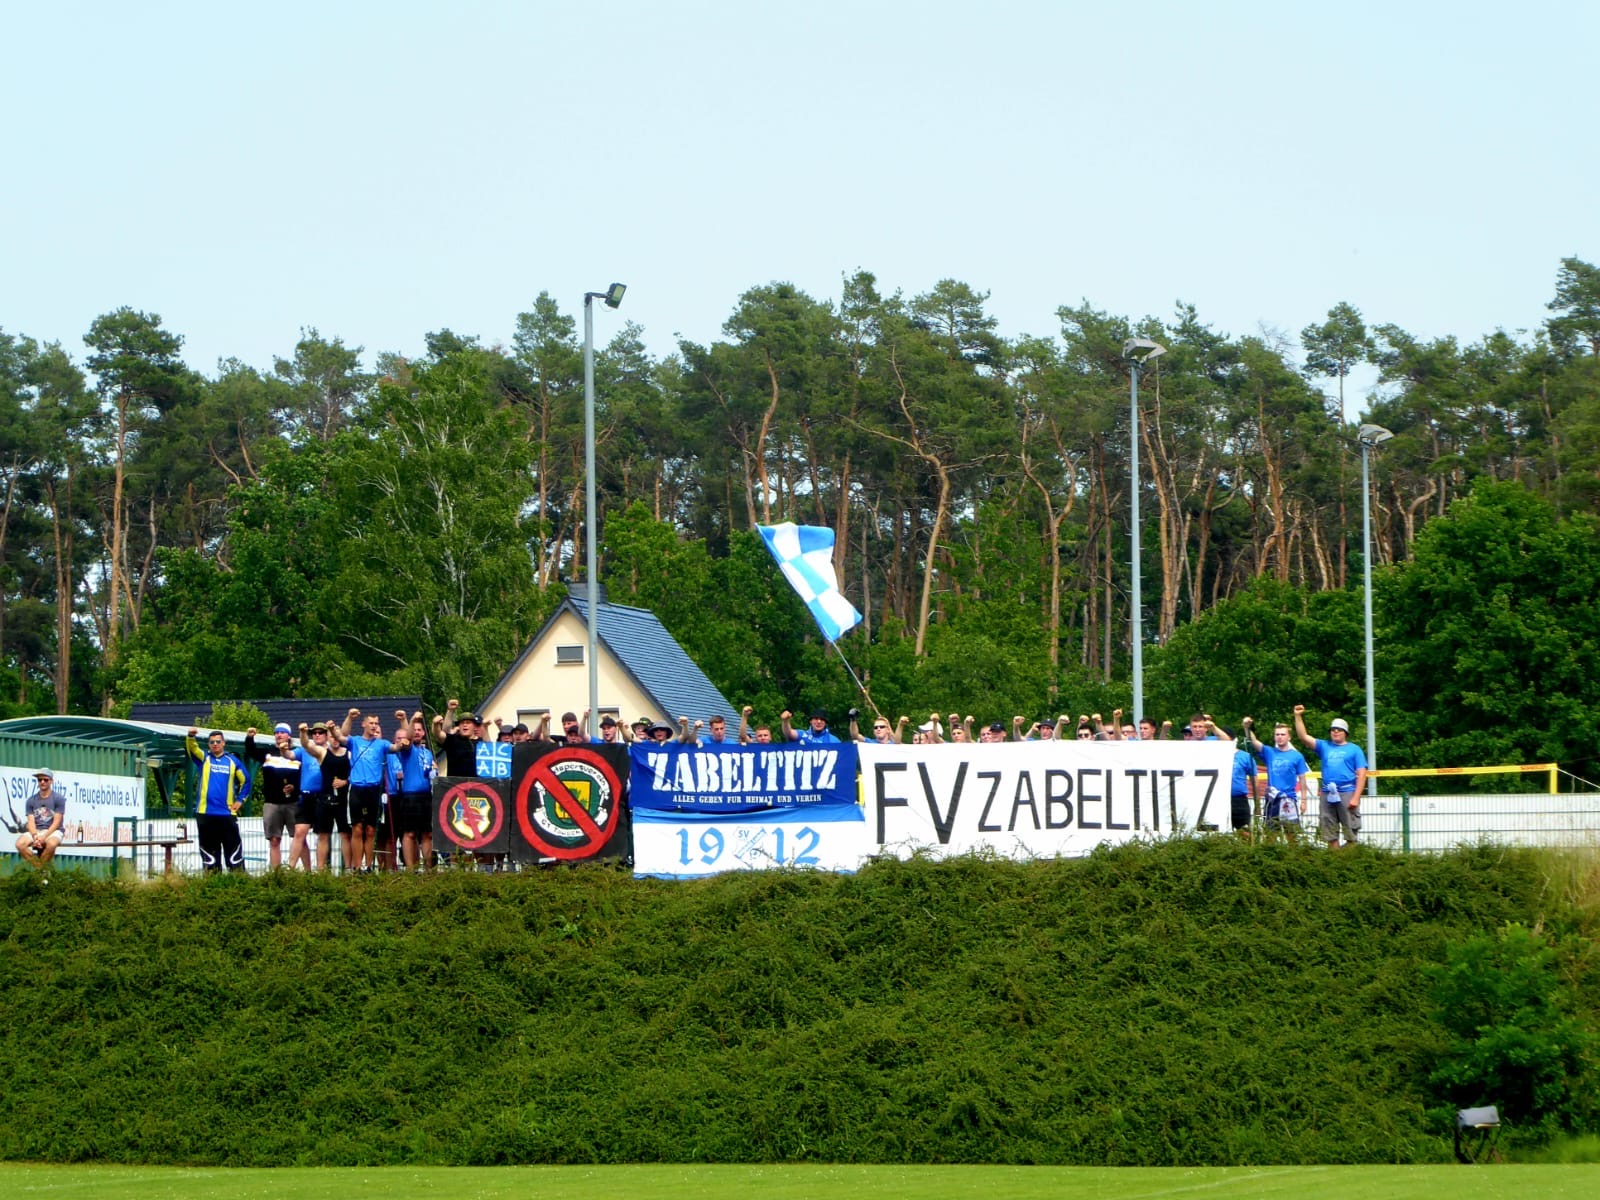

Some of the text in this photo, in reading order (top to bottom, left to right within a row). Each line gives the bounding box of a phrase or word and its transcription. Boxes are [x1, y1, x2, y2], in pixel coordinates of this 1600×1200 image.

[648, 750, 838, 793] ZABELTITZ
[11, 776, 29, 799] SSV
[125, 786, 140, 807] e.V.
[673, 795, 696, 803] ALLES
[698, 795, 723, 804] GEBEN
[745, 795, 773, 804] HEIMAT
[777, 795, 792, 803] UND
[795, 794, 822, 803] VEREIN
[874, 761, 1220, 845] FV ZABELTITZ
